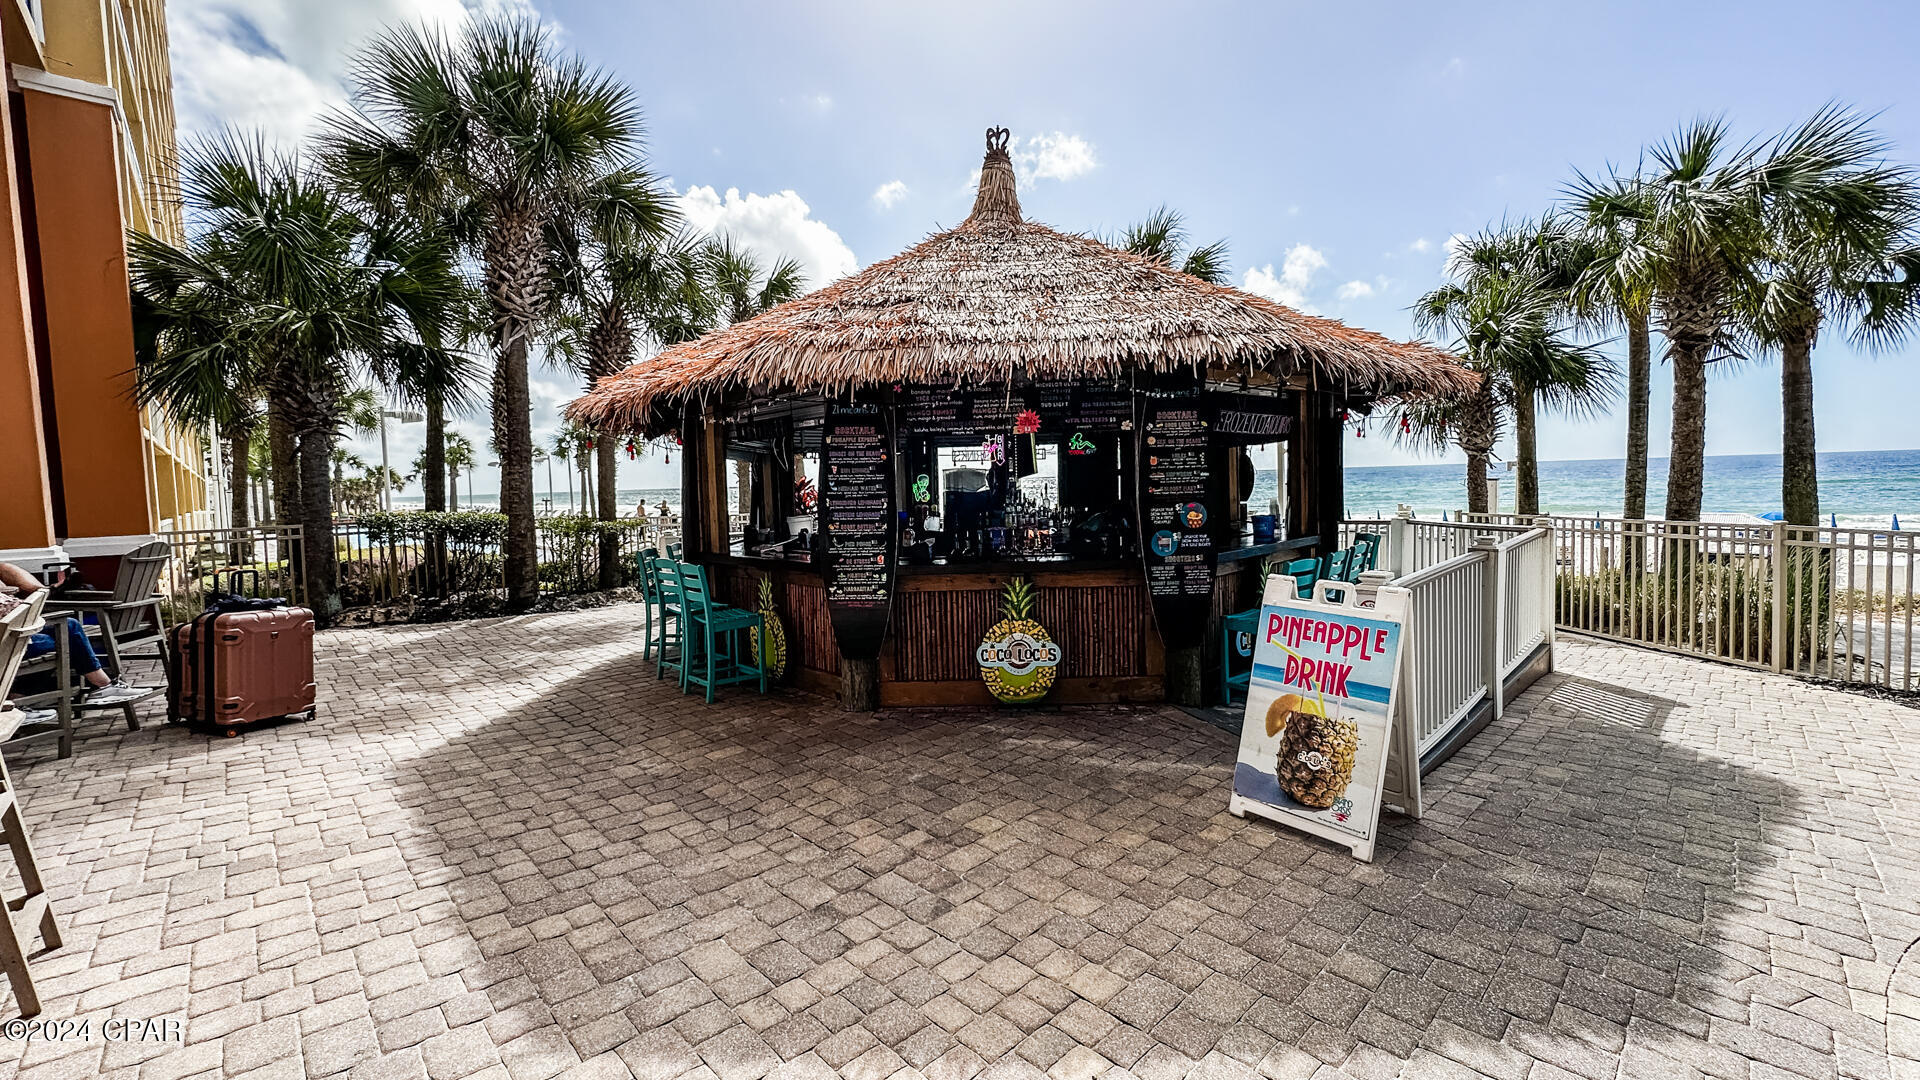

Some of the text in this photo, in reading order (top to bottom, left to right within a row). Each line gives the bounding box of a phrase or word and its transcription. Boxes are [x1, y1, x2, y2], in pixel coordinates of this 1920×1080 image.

[832, 404, 840, 414] 21
[871, 404, 878, 414] 21
[1156, 410, 1198, 420] COCKTAILS
[1213, 411, 1259, 434] FROZEN
[834, 426, 876, 435] COCKTAILS
[1266, 613, 1388, 662] PINEAPPLE
[980, 648, 1058, 663] COCO LOCOS
[1283, 654, 1353, 699] DRINK
